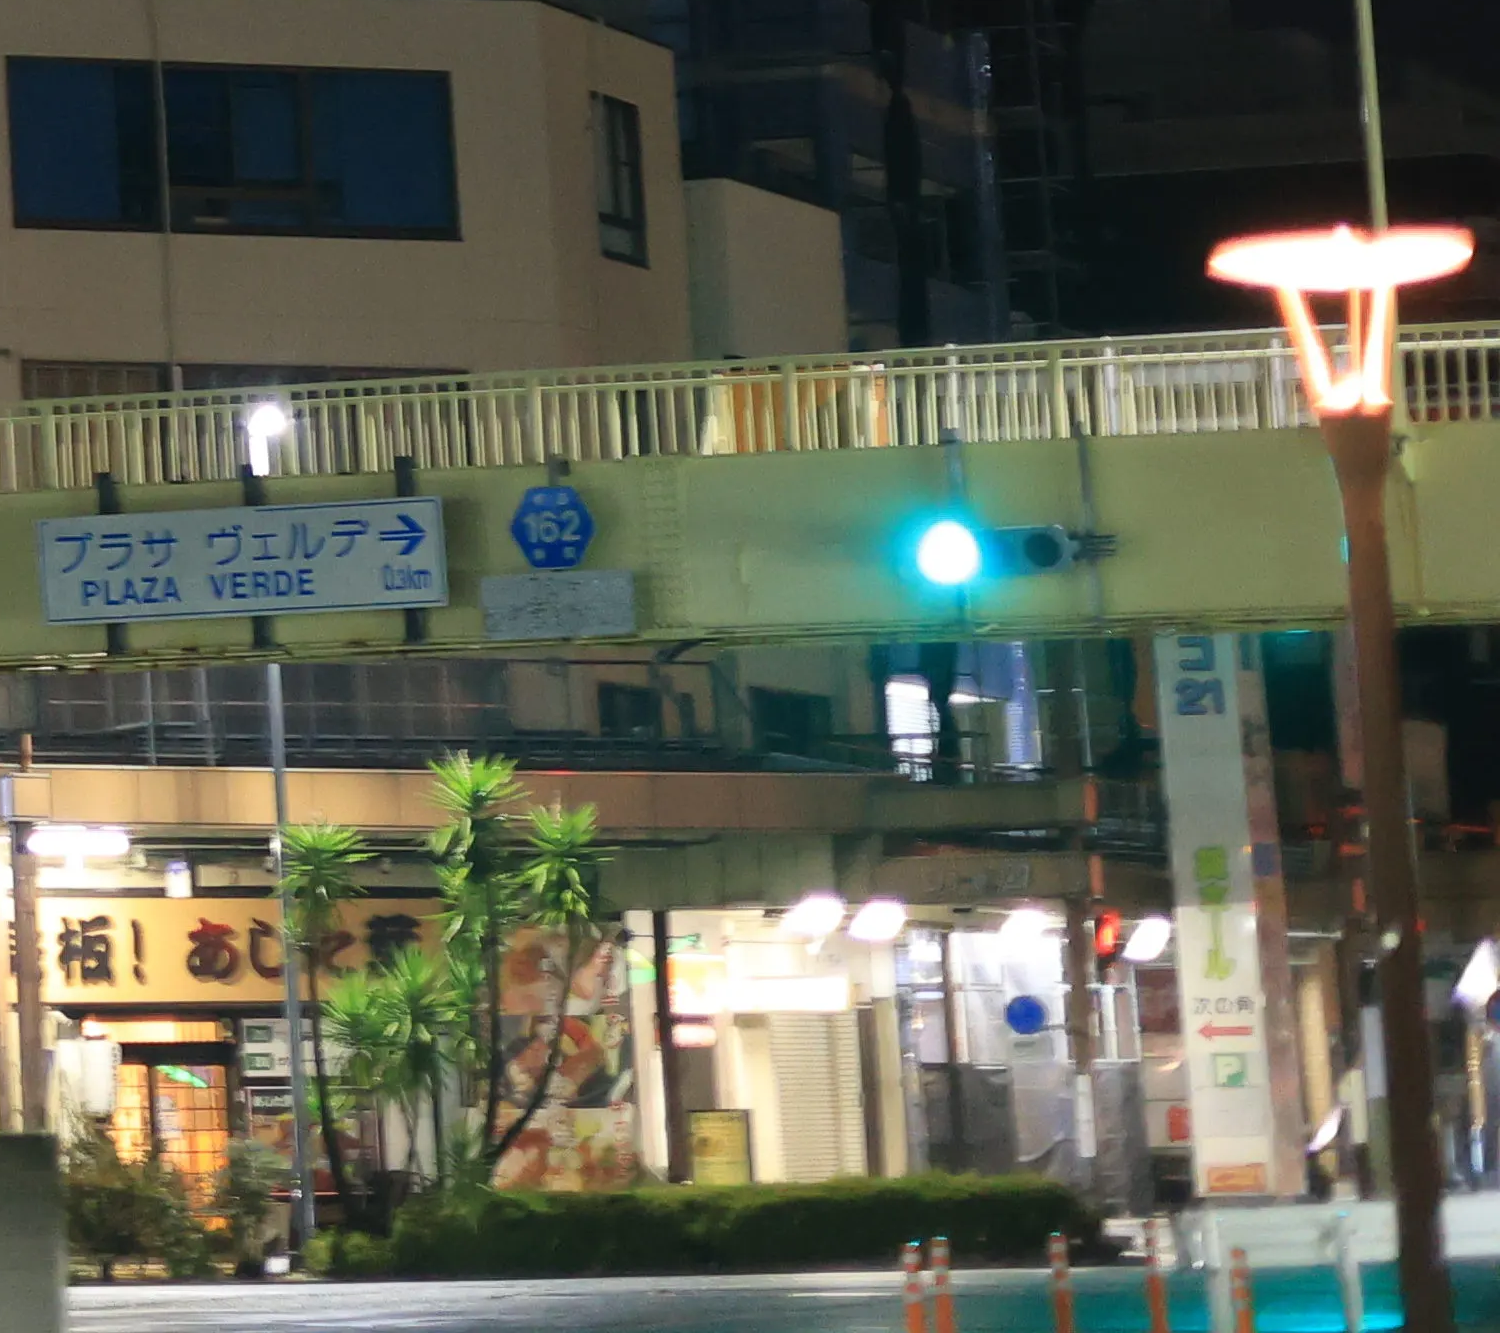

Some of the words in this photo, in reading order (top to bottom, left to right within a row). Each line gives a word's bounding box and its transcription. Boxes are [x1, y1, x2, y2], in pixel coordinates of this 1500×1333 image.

[523, 510, 581, 543] 162
[81, 577, 181, 606] PLAZA
[209, 569, 315, 600] VERDE
